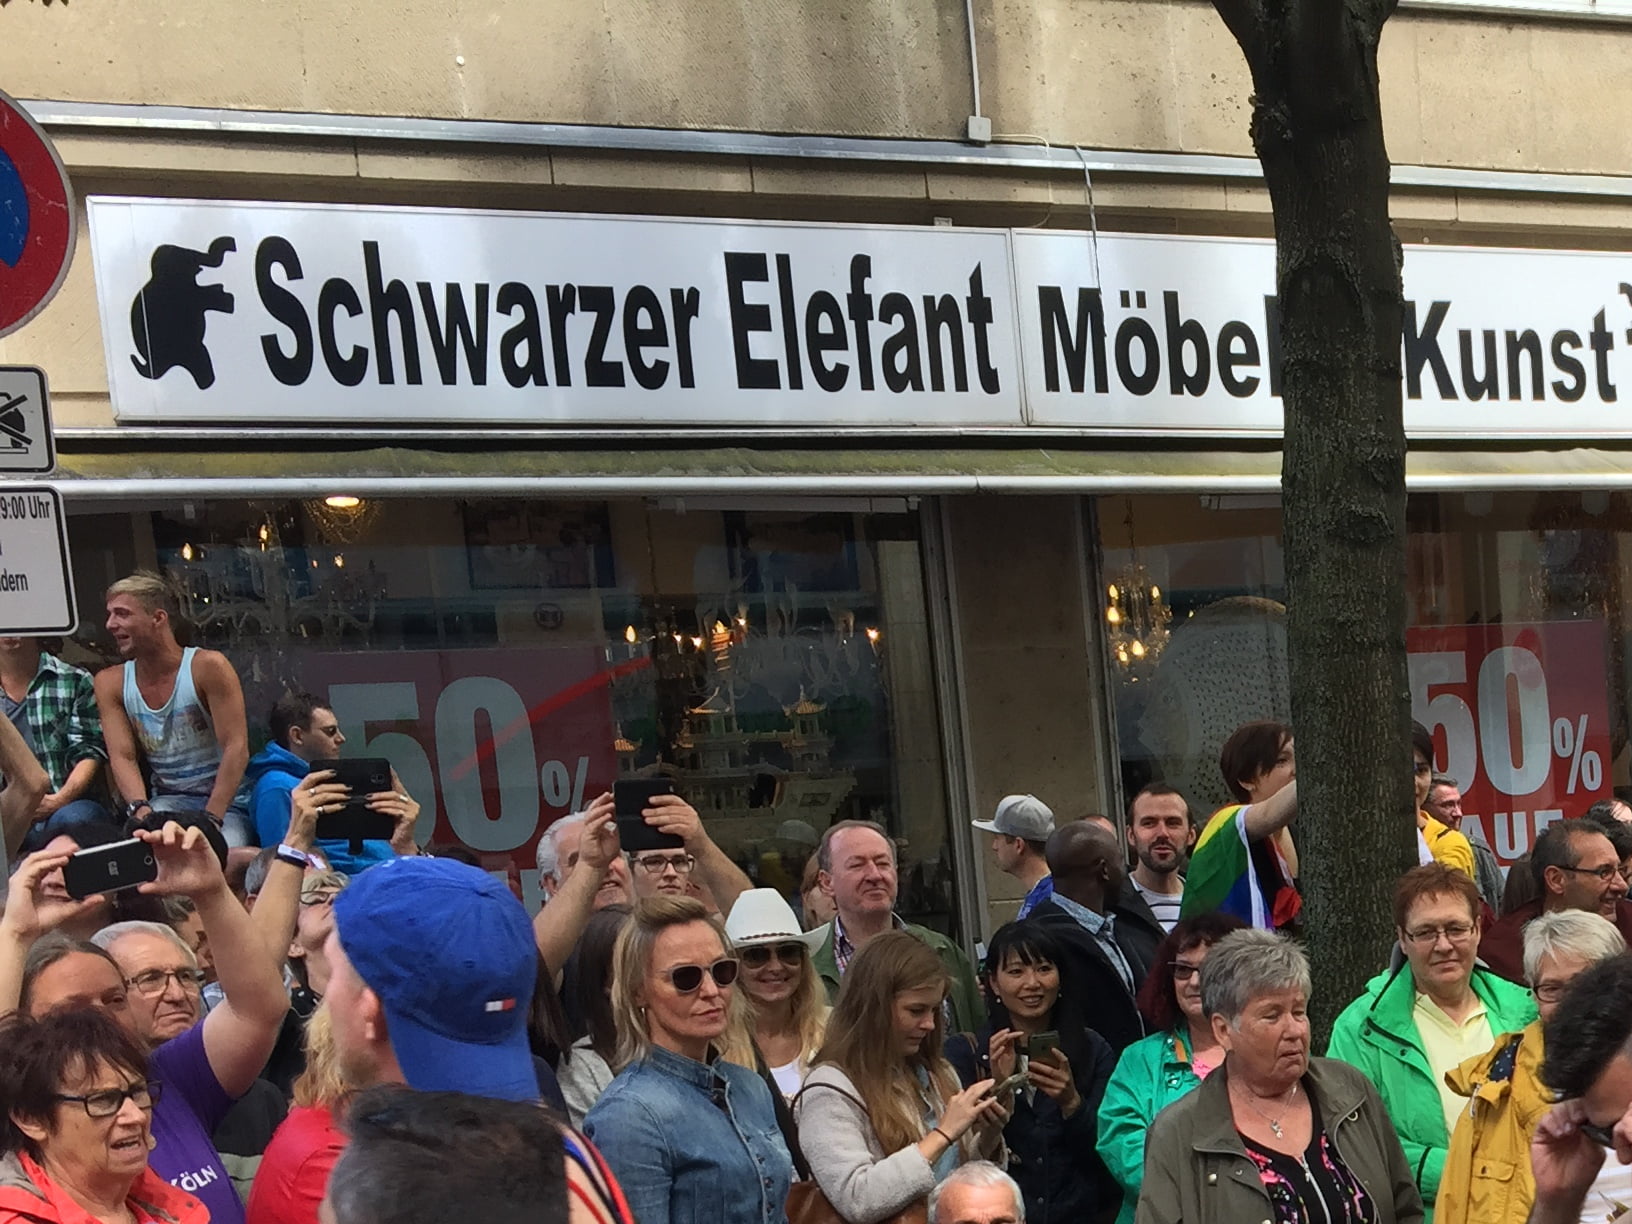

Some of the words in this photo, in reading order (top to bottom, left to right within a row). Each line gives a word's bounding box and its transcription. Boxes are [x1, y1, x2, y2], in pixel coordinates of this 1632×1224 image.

[255, 235, 700, 390] Schwarzer
[724, 250, 1001, 393] Elefant
[1402, 300, 1617, 403] Kunst
[28, 496, 50, 519] Uhr
[0, 568, 29, 592] dern
